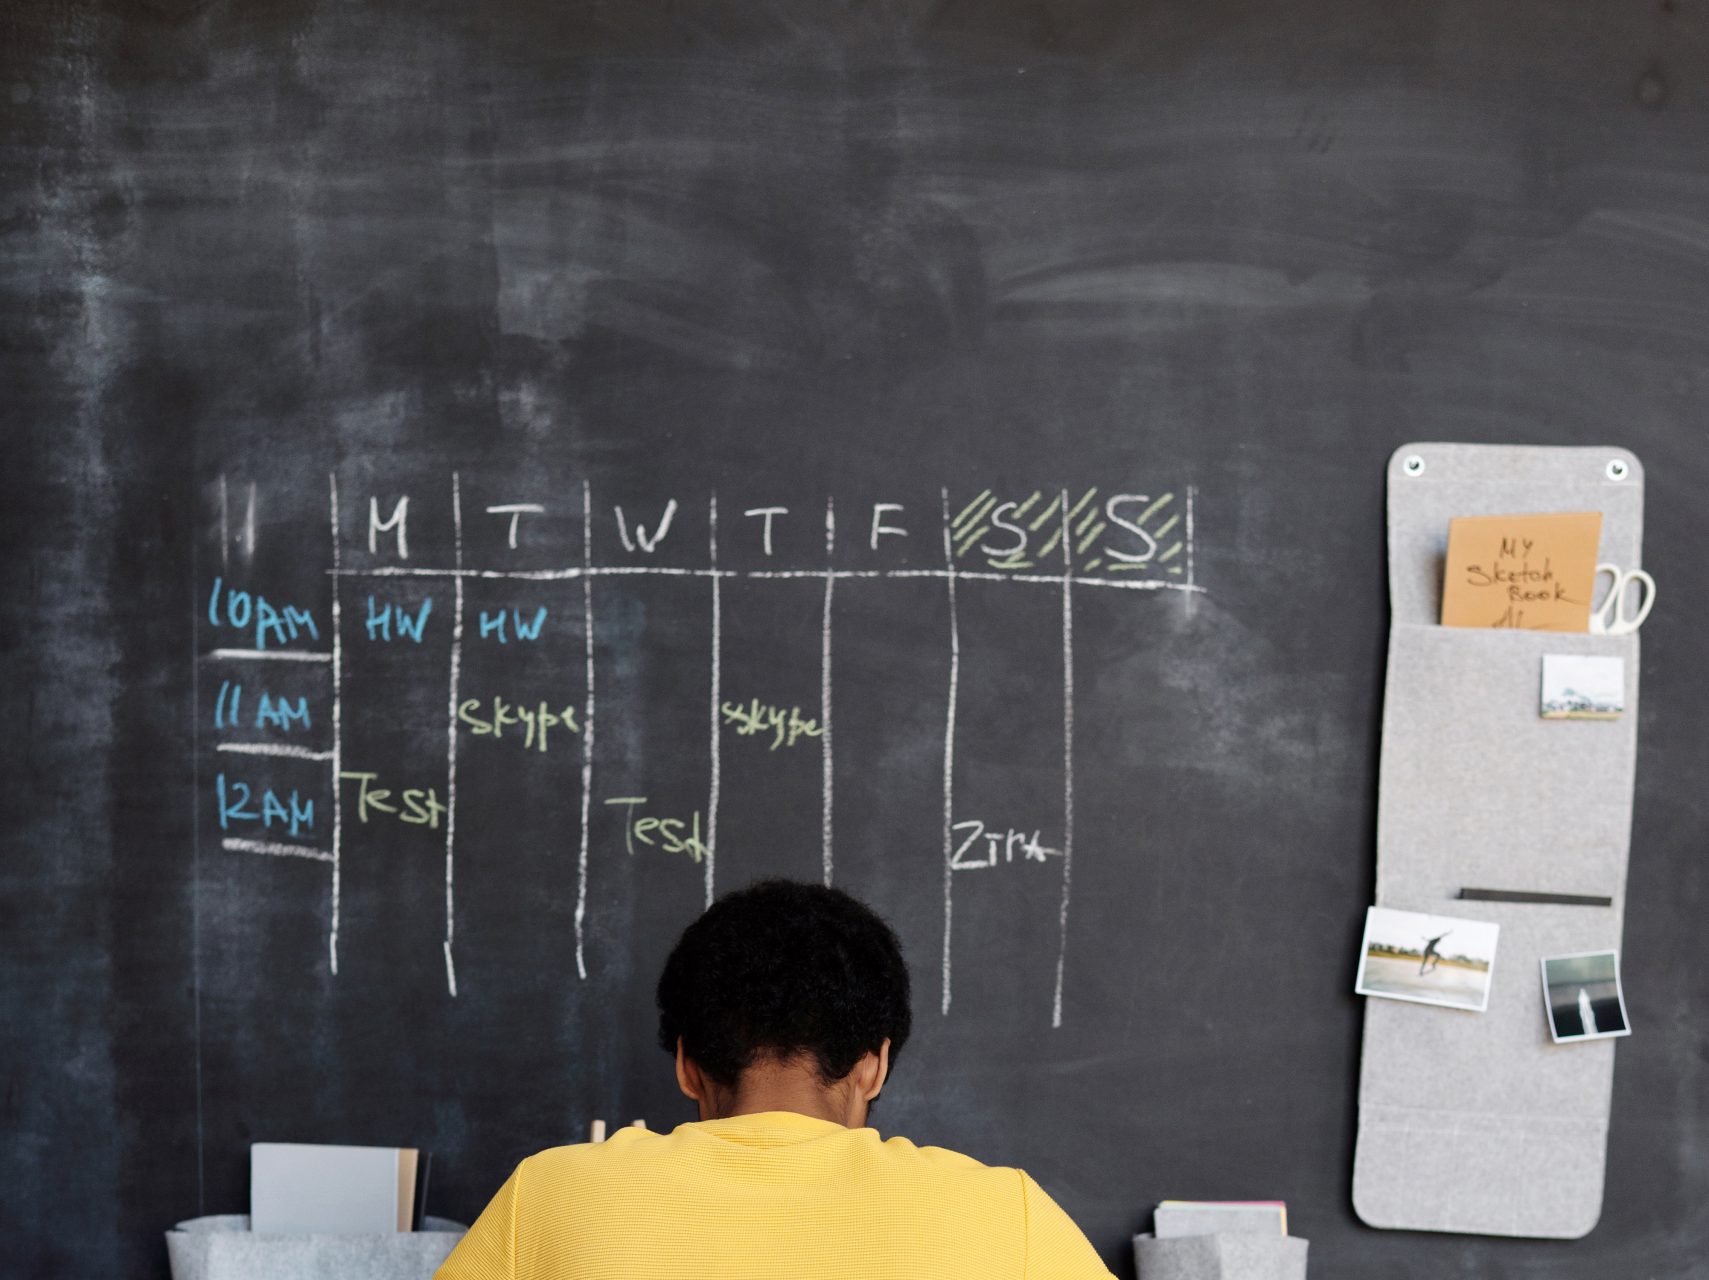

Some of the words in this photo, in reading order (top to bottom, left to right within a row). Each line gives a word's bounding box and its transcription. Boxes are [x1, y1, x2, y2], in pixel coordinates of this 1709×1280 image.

[368, 495, 409, 559] M
[486, 503, 545, 550] T
[614, 499, 677, 553] W
[744, 506, 789, 556] T
[870, 502, 909, 551] F
[980, 501, 1028, 557] S
[1104, 494, 1158, 562] S
[366, 595, 432, 643] HW
[479, 606, 547, 643] HW
